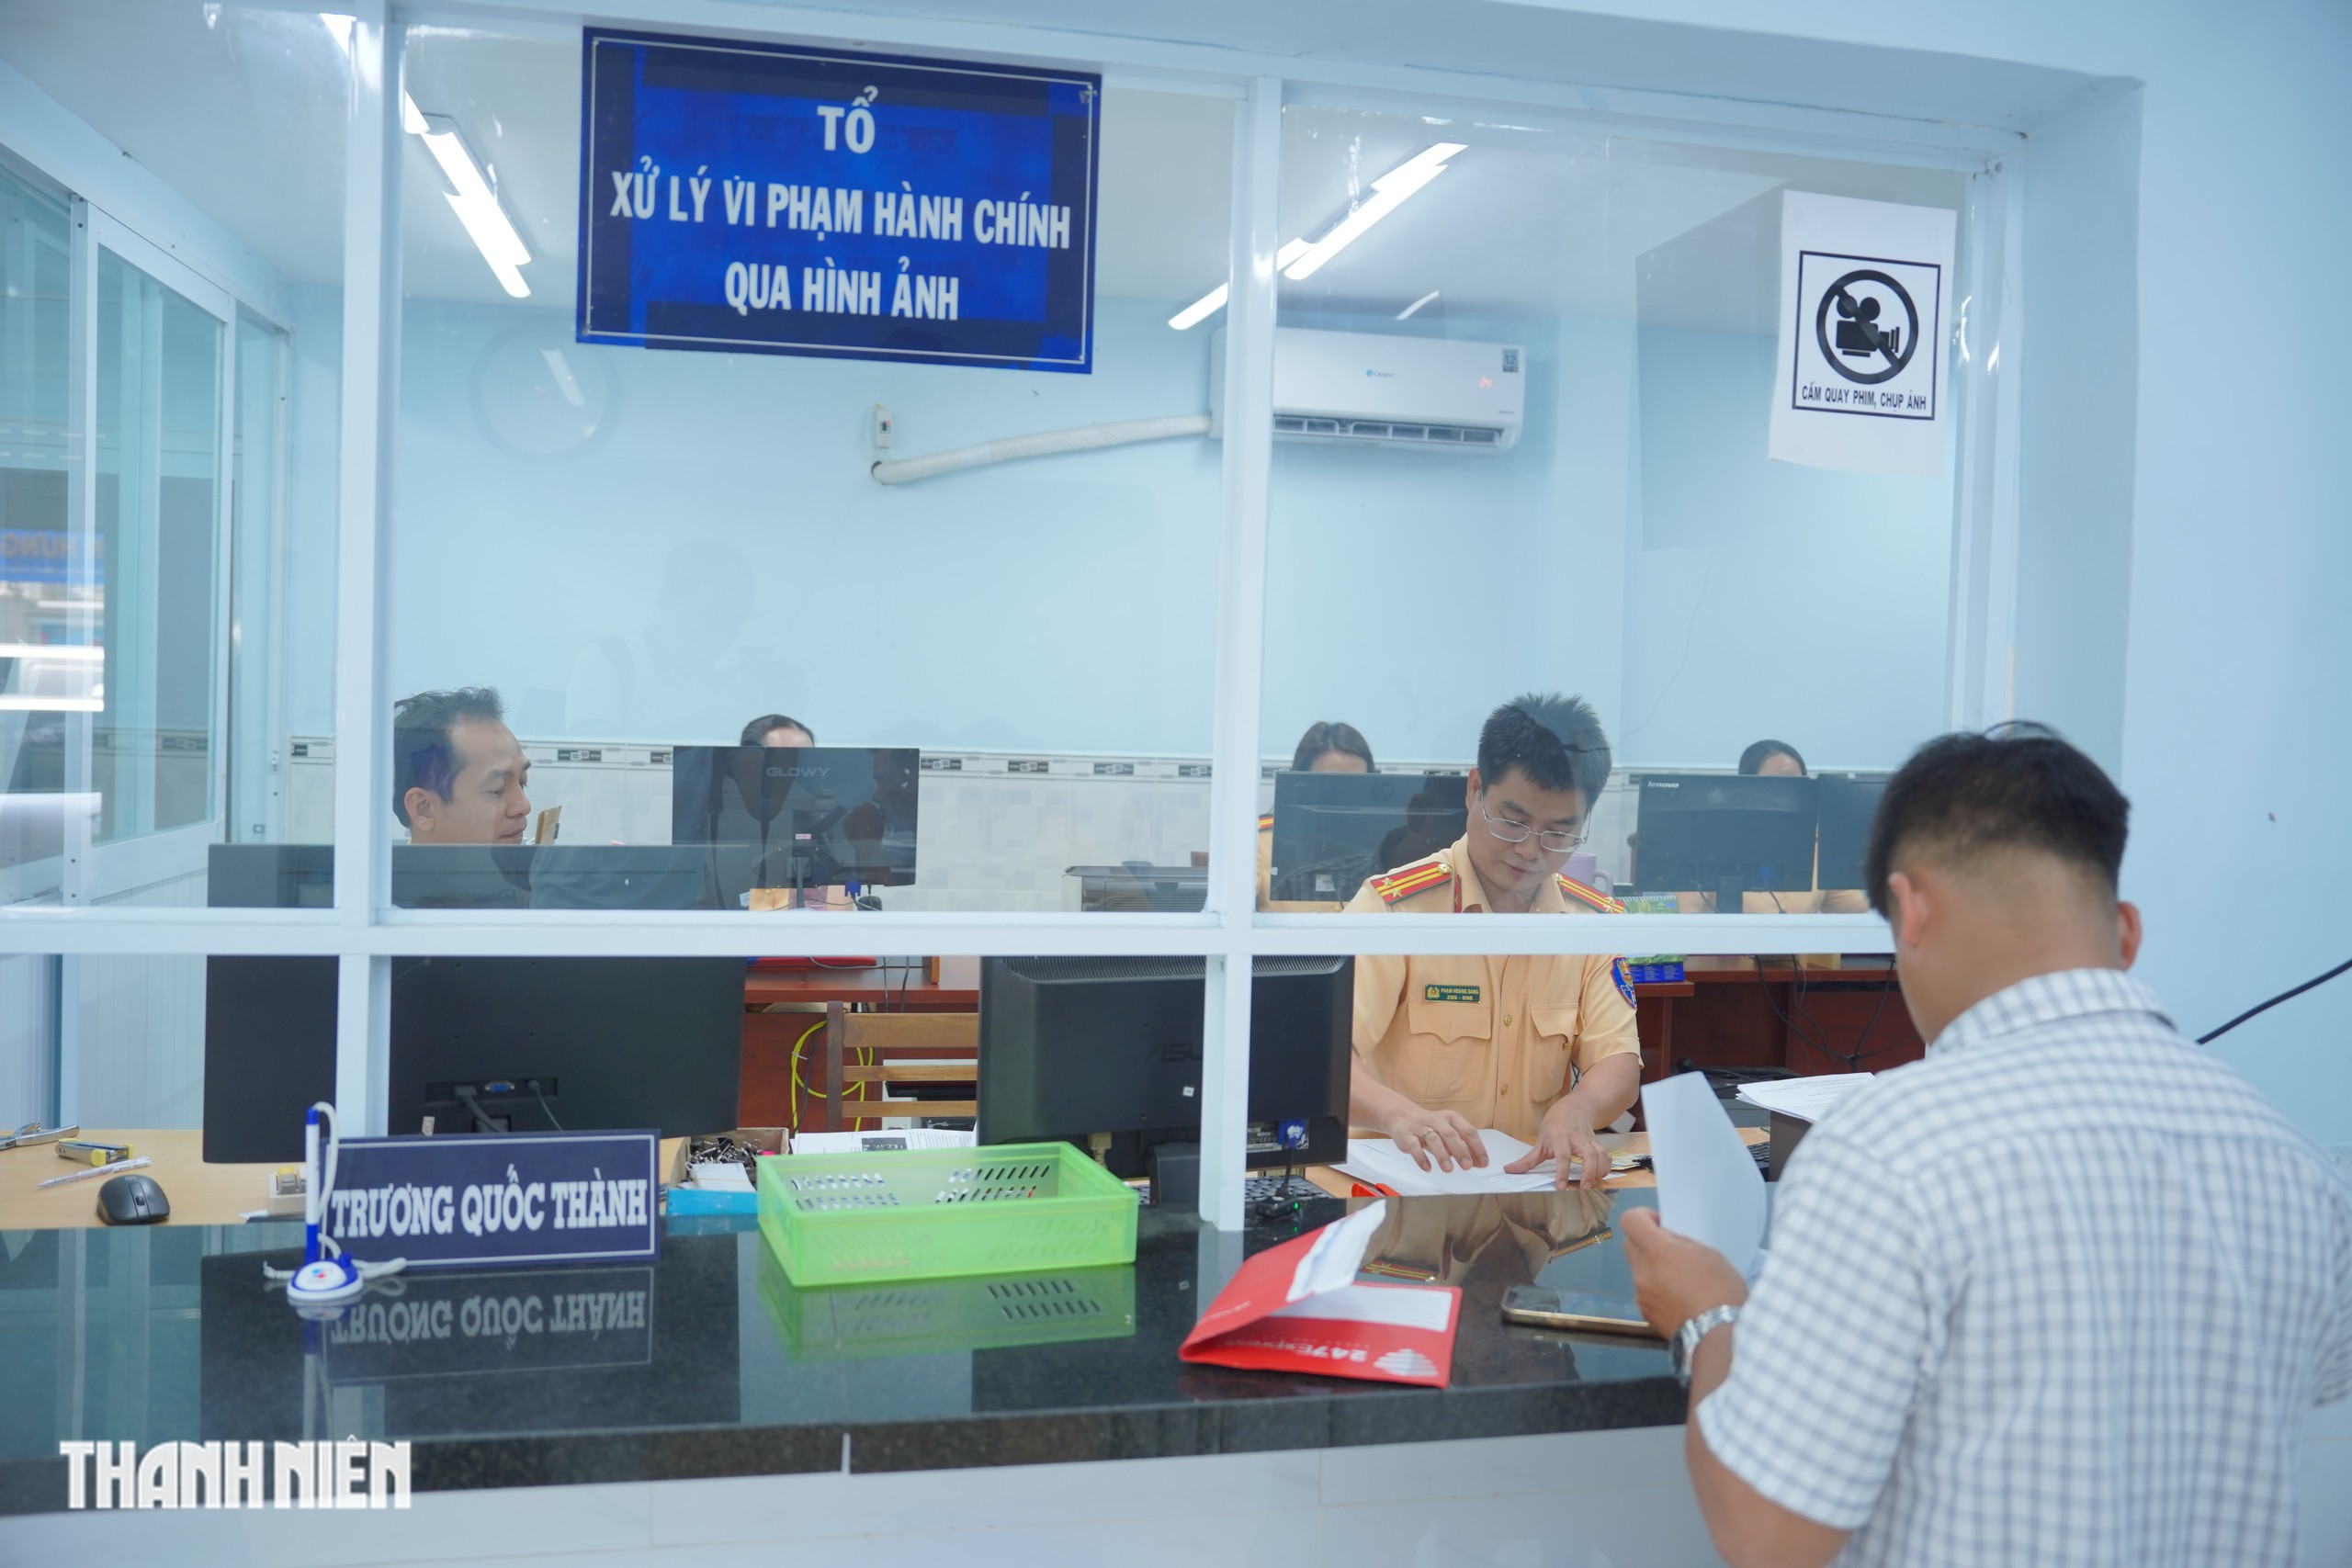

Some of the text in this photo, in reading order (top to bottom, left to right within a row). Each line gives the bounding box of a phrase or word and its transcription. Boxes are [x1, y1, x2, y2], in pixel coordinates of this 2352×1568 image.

[817, 85, 878, 154] TỔ
[609, 154, 1071, 249] XỬ LÝ VI PHẠM HÀNH CHÍNH
[725, 255, 959, 321] QUA HÌNH ẢNH
[1802, 380, 1822, 401] CẤM
[1825, 388, 1849, 404] QUAY
[1853, 389, 1877, 409] PHIM,
[1880, 392, 1904, 412] CHỤP
[766, 767, 830, 777] GLOWY
[332, 1163, 648, 1238] TRƯƠNG QUỐC THÀNH
